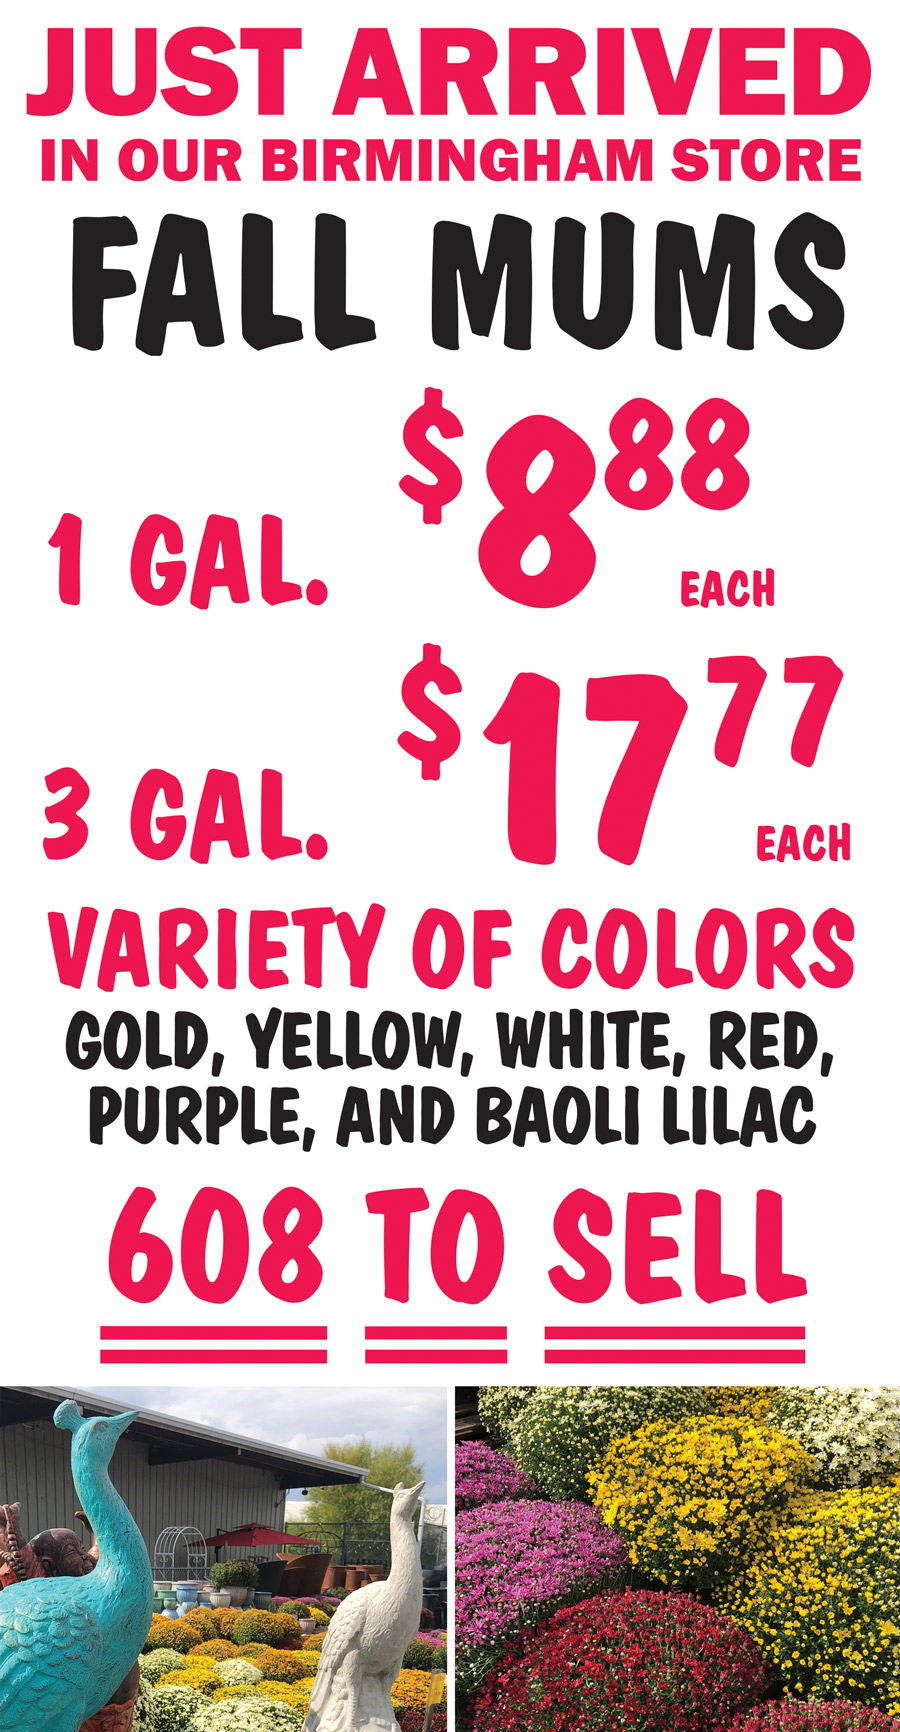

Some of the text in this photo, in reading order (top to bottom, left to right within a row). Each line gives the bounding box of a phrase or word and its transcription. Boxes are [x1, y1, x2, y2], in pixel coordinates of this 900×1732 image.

[27, 27, 872, 117] JUST ARRIVED
[42, 138, 862, 182] IN OUR BIRMINGHAM STORE
[72, 211, 846, 357] FALL MUMS
[48, 513, 329, 609] 1 GAL.
[680, 567, 775, 609] EACH
[42, 766, 329, 865] 3 GAL.
[756, 822, 852, 863] EACH
[47, 903, 855, 993] VARIETY OF COLORS
[65, 1007, 834, 1078] GOLD, YELLOW, WHITE, RED,
[89, 1084, 817, 1153] PURPLE, AND BAOLI LILAC
[108, 1186, 808, 1305] 608 TO SELL
